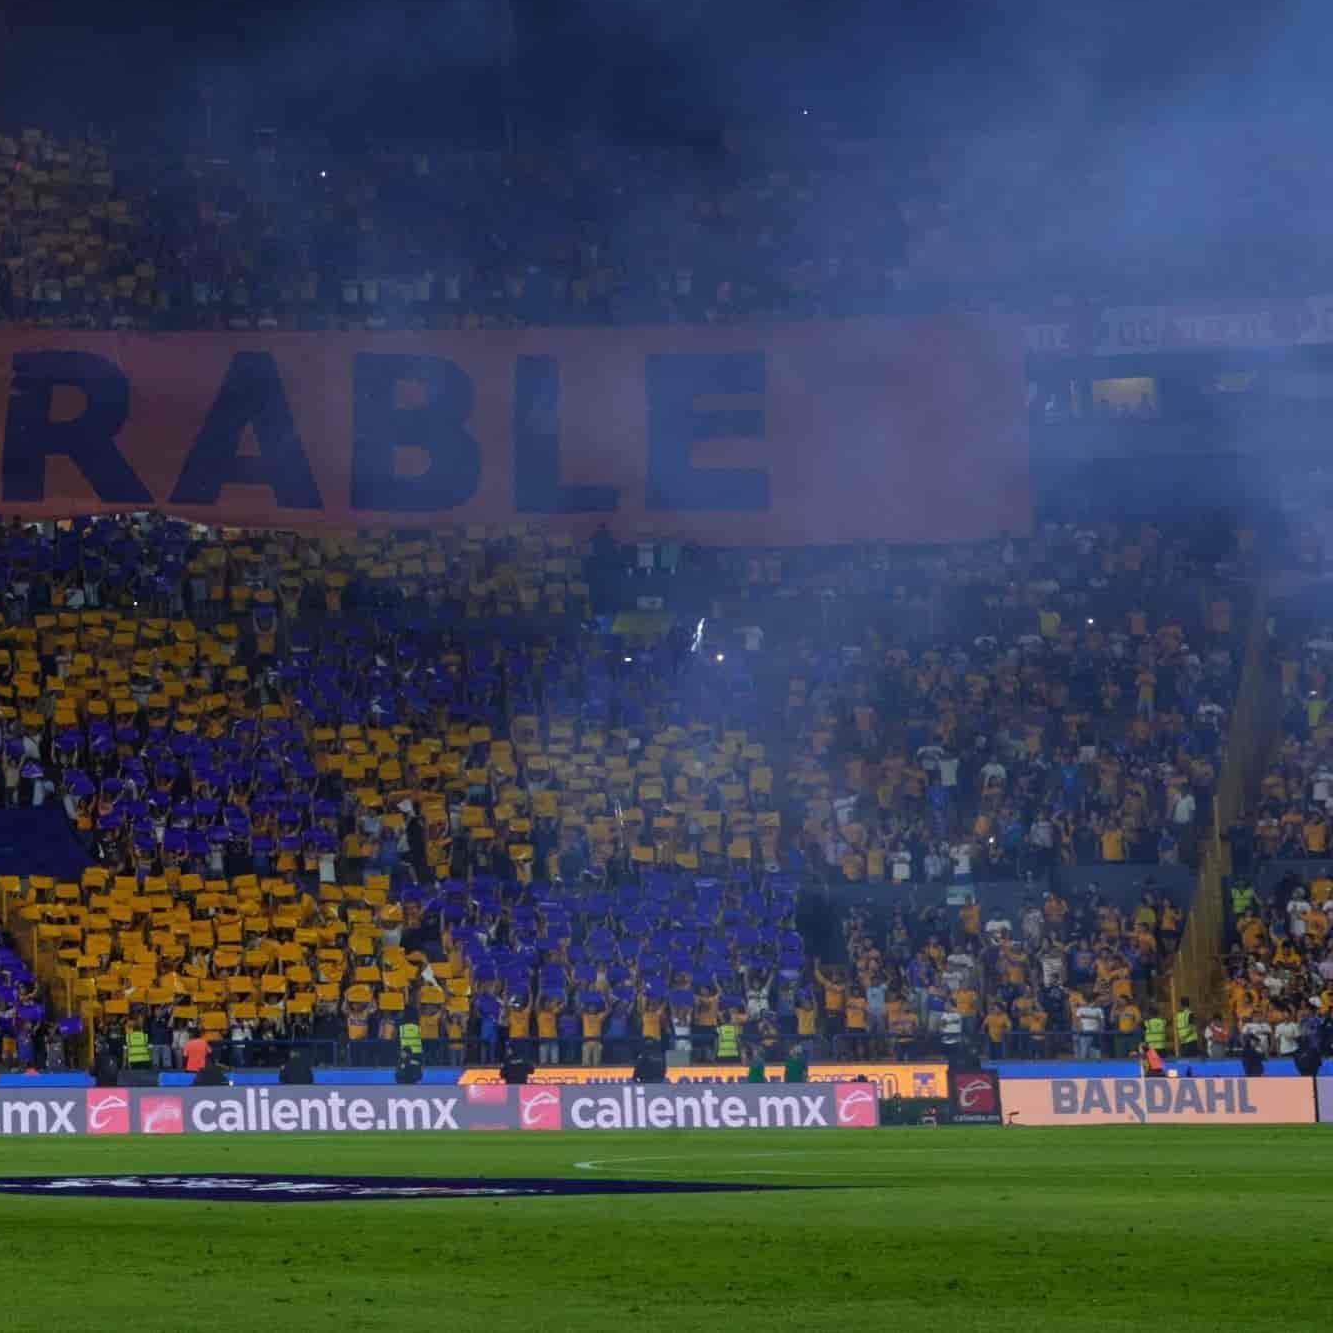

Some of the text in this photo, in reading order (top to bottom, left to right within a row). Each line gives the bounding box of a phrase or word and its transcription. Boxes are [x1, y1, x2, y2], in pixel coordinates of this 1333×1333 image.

[191, 1088, 458, 1132] caliente.mx
[571, 1086, 828, 1127] caliente.mx
[1052, 1078, 1257, 1122] BARDAHL
